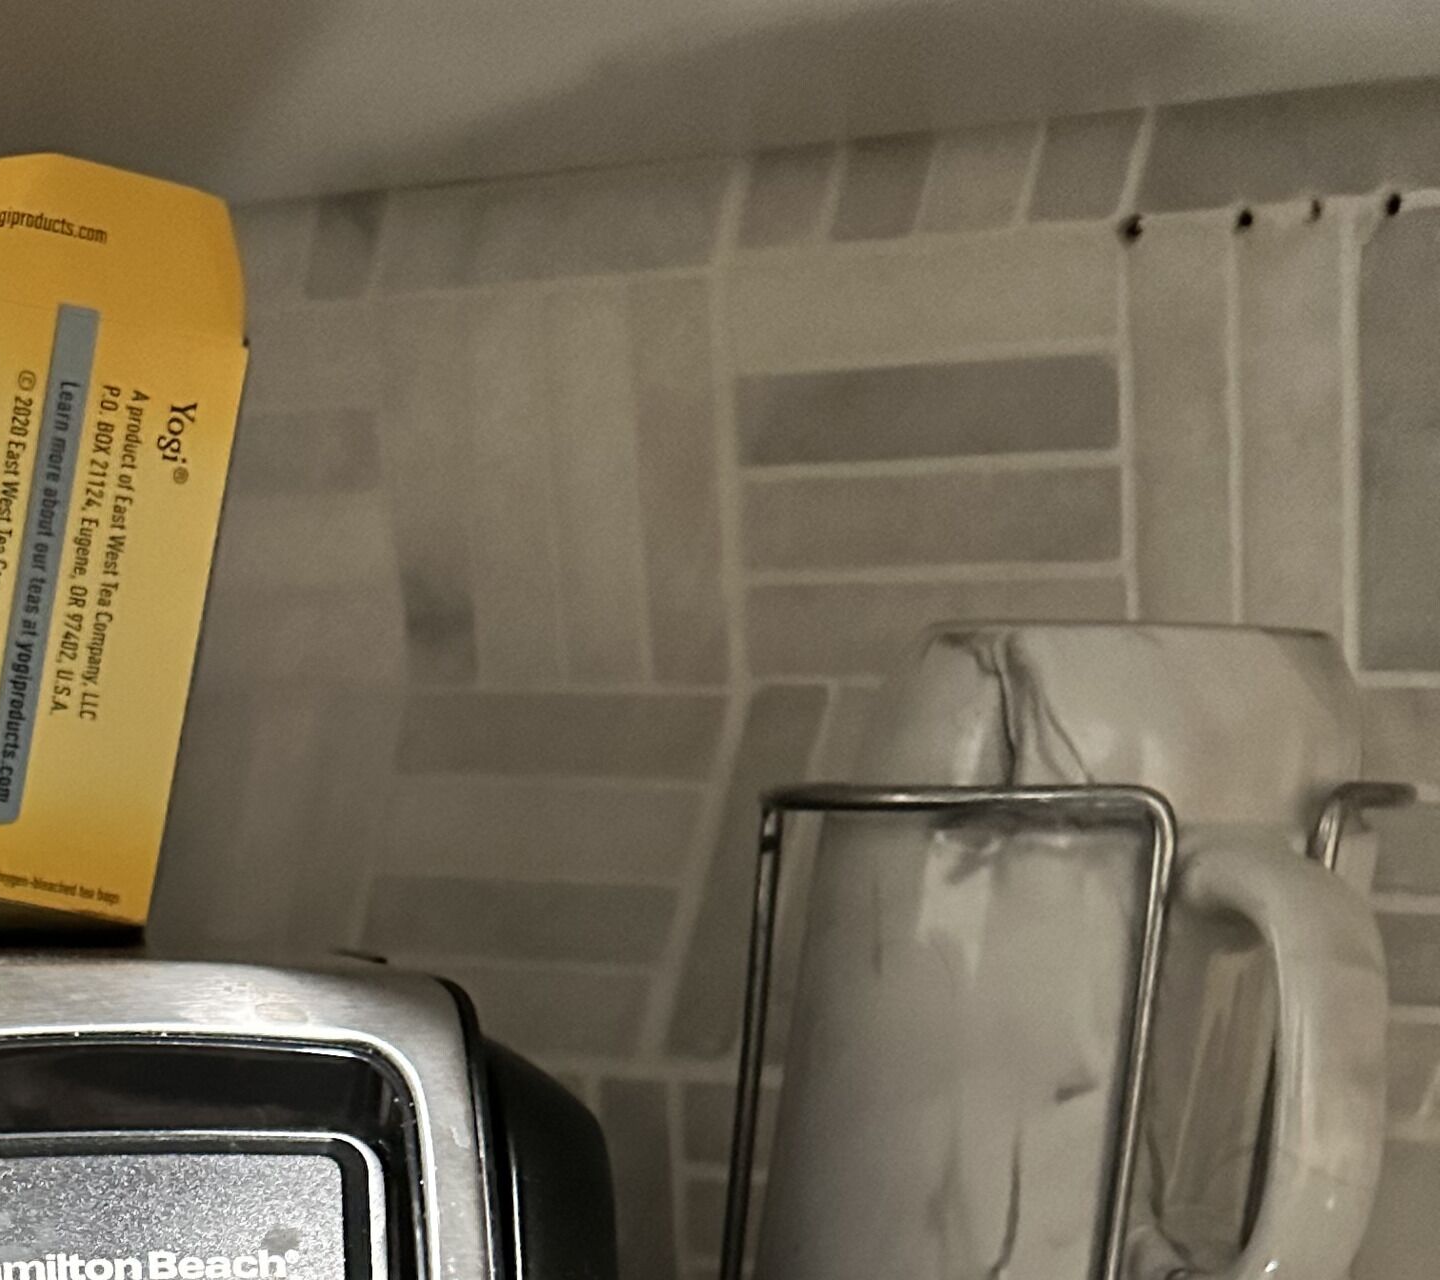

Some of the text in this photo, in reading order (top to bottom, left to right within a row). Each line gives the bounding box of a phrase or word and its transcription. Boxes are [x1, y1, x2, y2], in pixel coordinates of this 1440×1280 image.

[10, 395, 34, 438] 2020
[56, 381, 81, 432] Learn
[4, 440, 27, 477] East
[46, 436, 68, 483] more
[36, 487, 58, 539] about
[30, 542, 49, 571] our
[49, 384, 122, 716] P.O. BOX 21124, Eugene, OR 97402, U.S.A.
[79, 389, 150, 722] A product of East West Tea Company, LLC
[23, 577, 47, 616] teas
[20, 619, 40, 637] at
